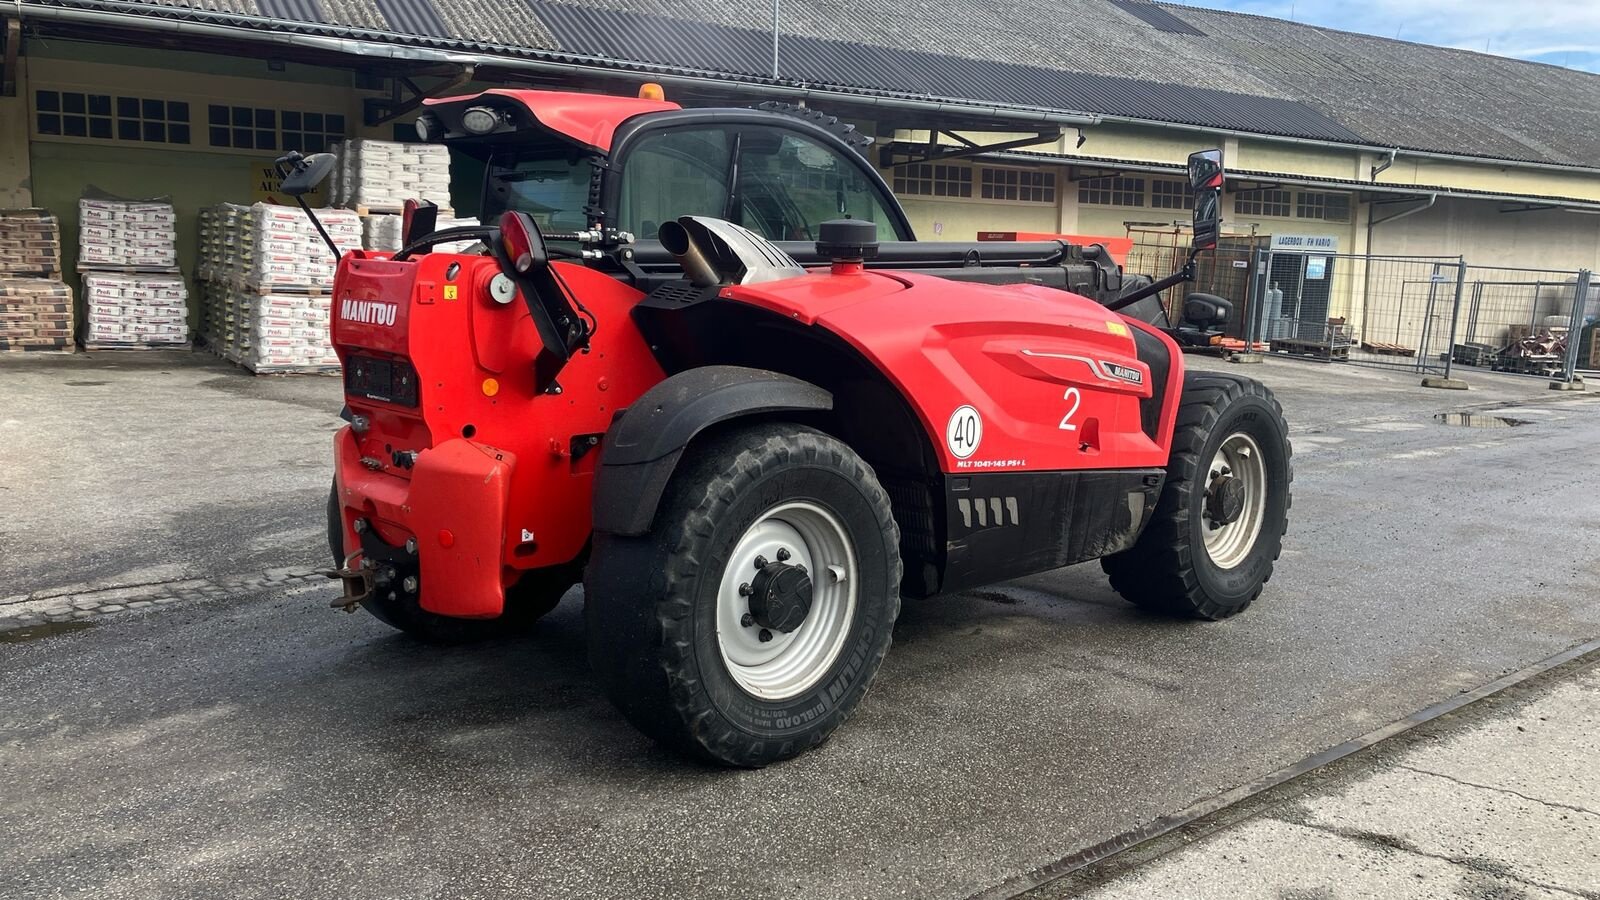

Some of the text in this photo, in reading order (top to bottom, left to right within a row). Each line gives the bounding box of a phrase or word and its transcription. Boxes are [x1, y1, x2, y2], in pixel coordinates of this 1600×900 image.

[341, 299, 397, 326] MANITOU
[1114, 366, 1140, 381] MANITOU
[1059, 387, 1080, 431] 2
[954, 415, 976, 449] 40
[974, 460, 1006, 468] 1041-145
[828, 600, 879, 702] MICHELIN
[776, 703, 827, 730] BIBLOAD
